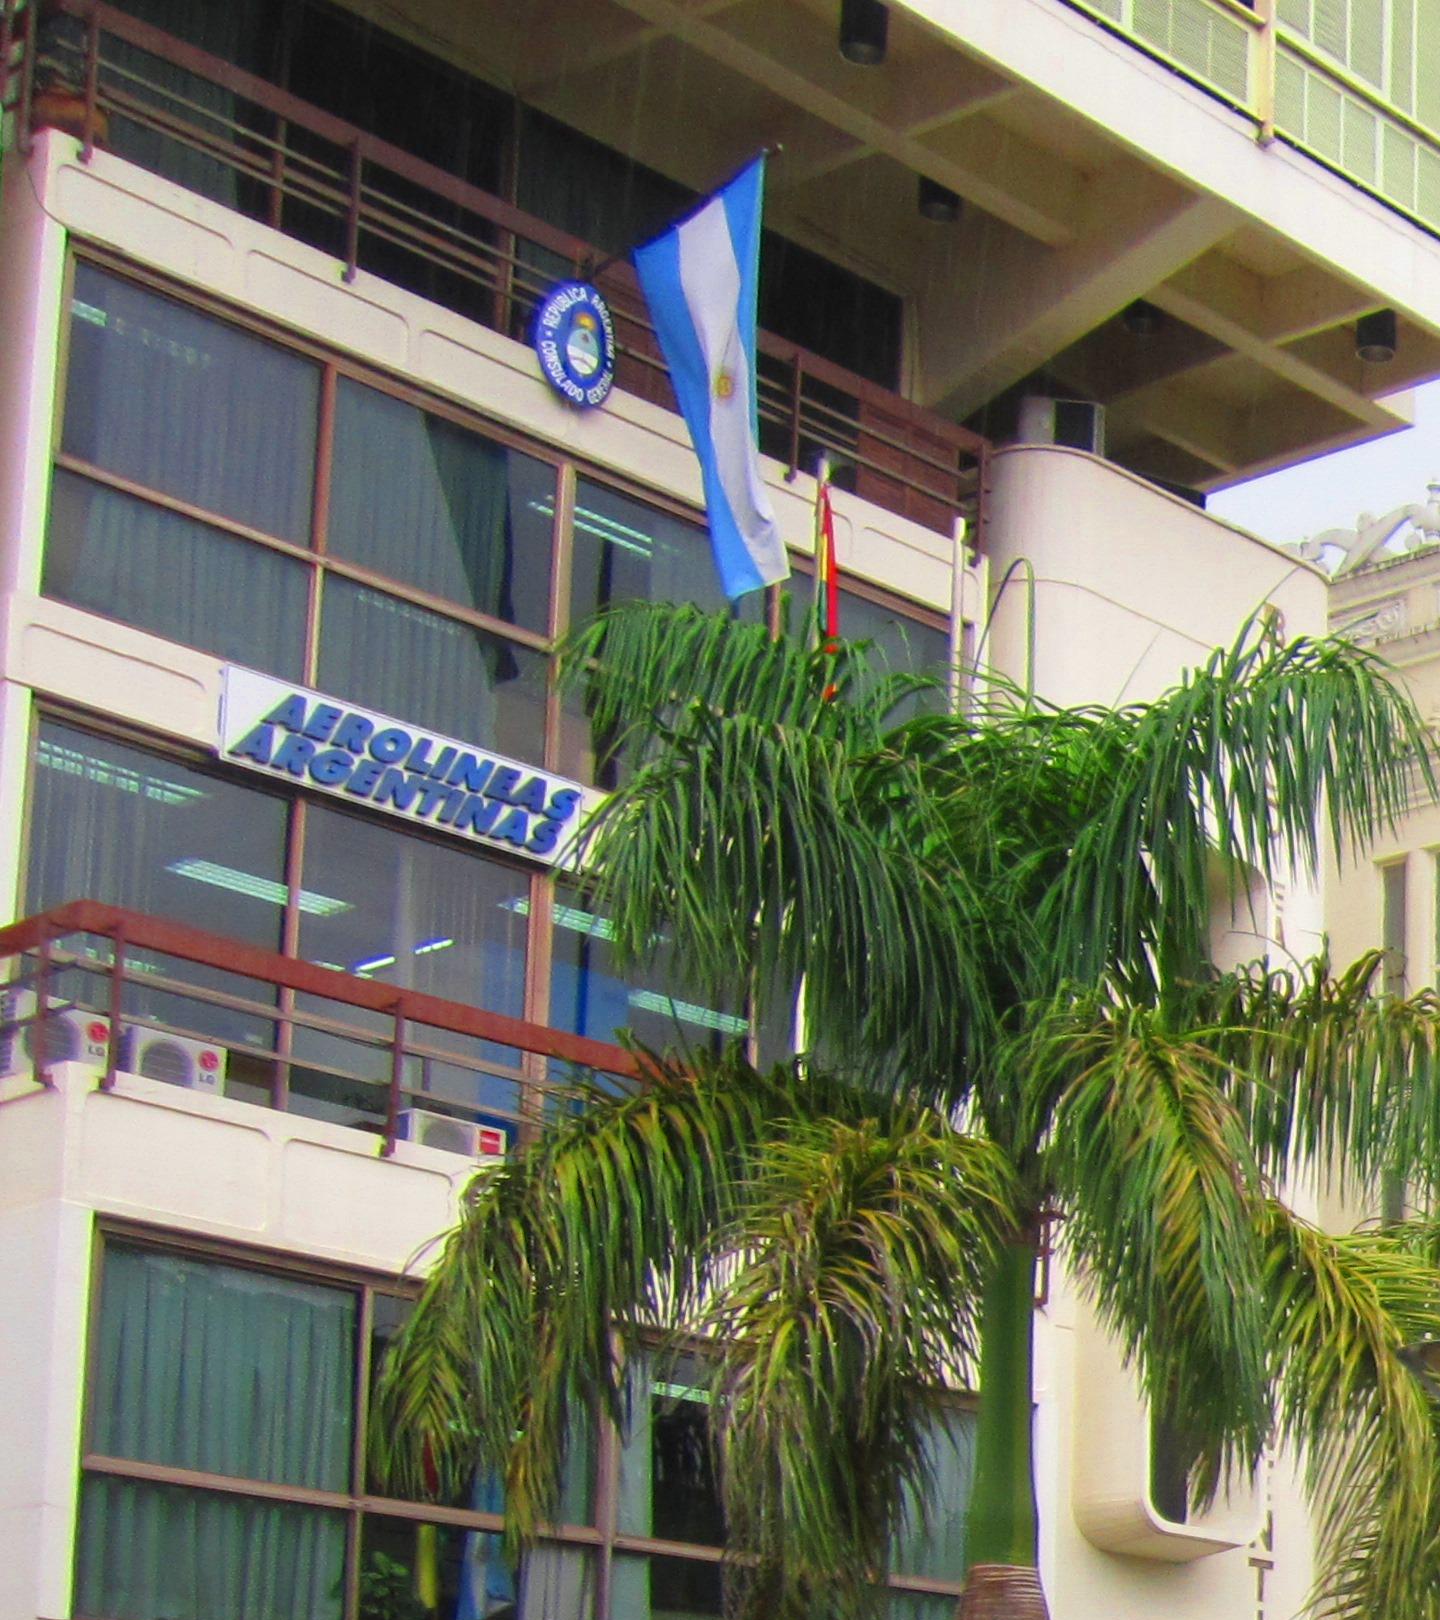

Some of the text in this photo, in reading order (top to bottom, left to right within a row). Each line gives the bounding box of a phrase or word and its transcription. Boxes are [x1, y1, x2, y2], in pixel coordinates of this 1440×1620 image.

[541, 340, 585, 402] CONSULADO
[228, 723, 564, 854] ARGENTINAS
[260, 693, 583, 822] AEROLINEAS
